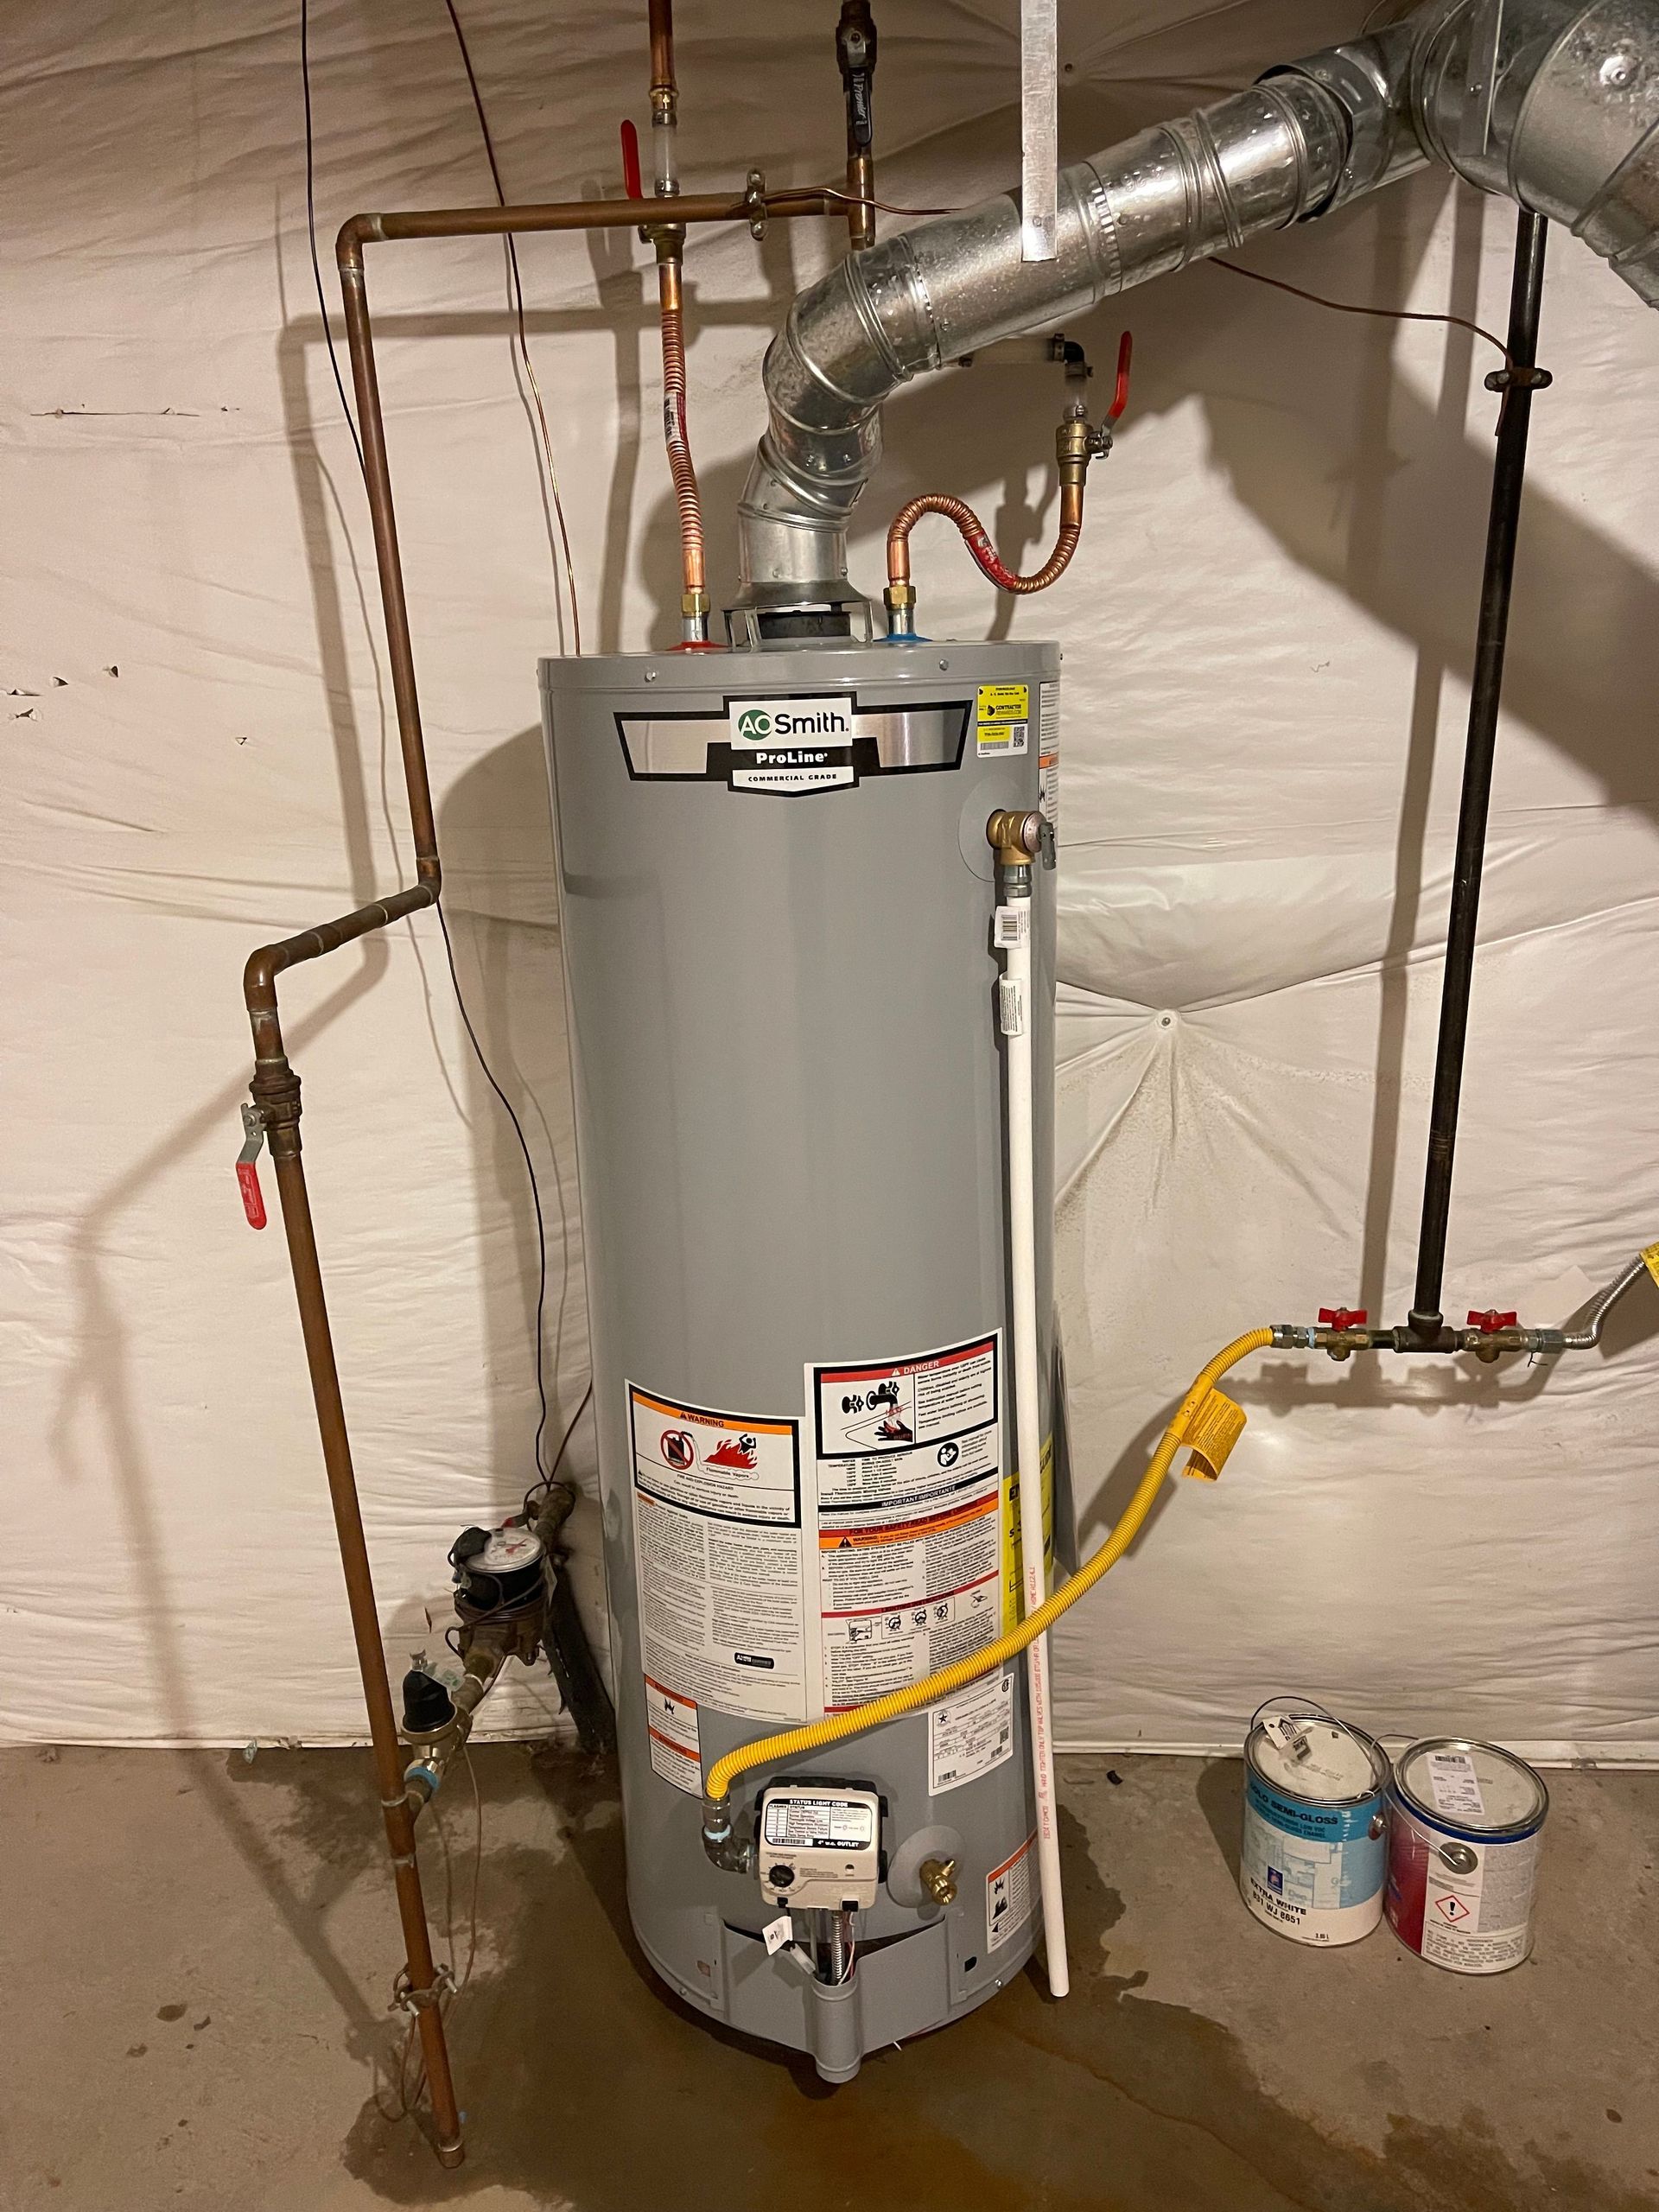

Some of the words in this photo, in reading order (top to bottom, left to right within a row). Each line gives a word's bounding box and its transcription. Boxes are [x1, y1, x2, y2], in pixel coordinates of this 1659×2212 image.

[756, 751, 824, 765] ProLine
[904, 1360, 939, 1375] DANGER
[688, 1414, 724, 1428] WARNING
[1271, 1802, 1338, 1825] SEMI-GLOSS
[1250, 1877, 1274, 1902] EXTRA
[1276, 1897, 1307, 1916] WHITE
[1280, 1910, 1301, 1925] 8651
